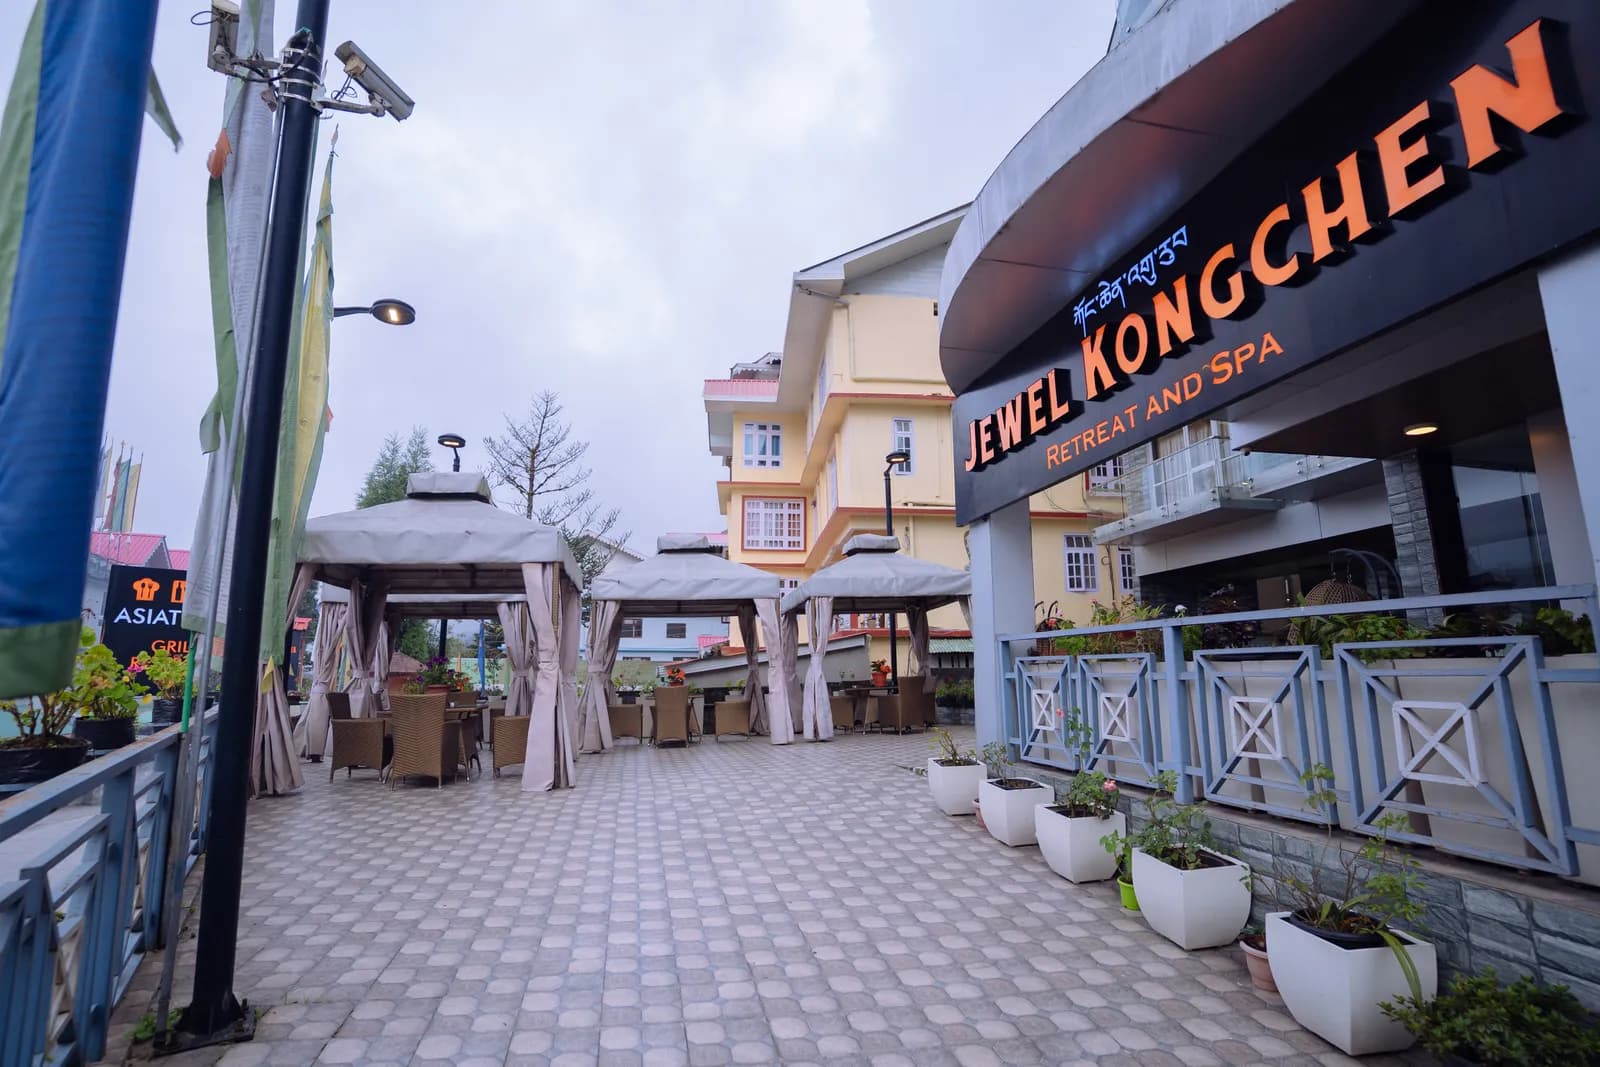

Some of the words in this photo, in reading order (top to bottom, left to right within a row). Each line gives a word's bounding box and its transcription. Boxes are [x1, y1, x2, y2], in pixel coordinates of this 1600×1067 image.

[965, 368, 1070, 472] JEWEL
[1081, 18, 1564, 401] KONGCHEN
[1046, 405, 1139, 470] RETREAT
[1145, 371, 1204, 421] AND
[1207, 332, 1284, 386] SPA
